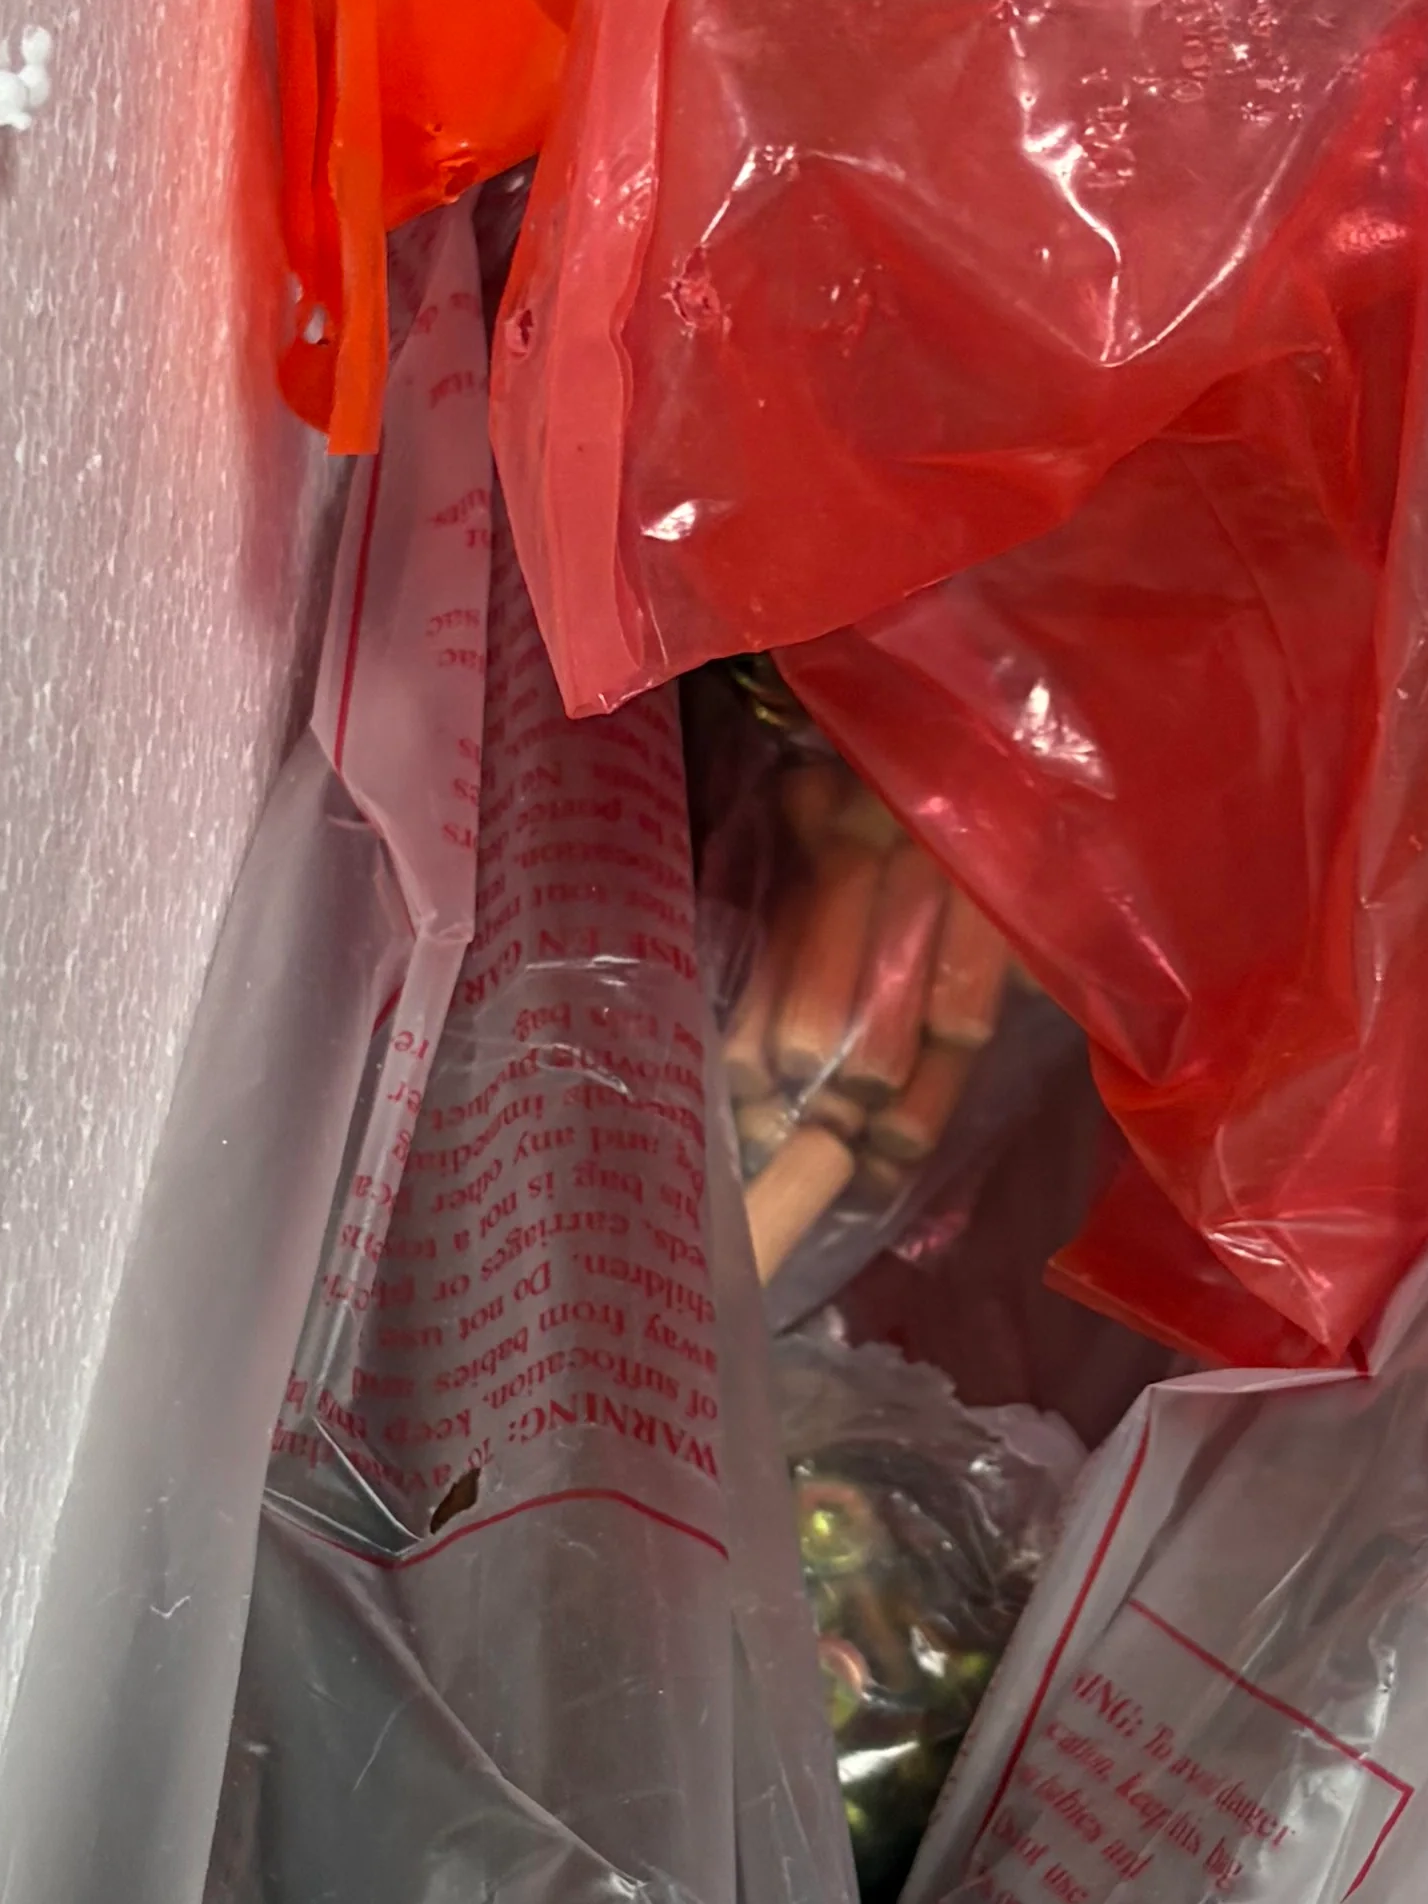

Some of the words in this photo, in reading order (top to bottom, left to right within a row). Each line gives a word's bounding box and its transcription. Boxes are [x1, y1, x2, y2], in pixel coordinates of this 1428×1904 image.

[527, 1170, 556, 1202] is
[452, 1228, 471, 1253] a
[481, 1211, 630, 1283] carriages
[434, 1273, 471, 1302] or
[512, 1259, 553, 1302] Do
[458, 1295, 505, 1341] not
[538, 1300, 625, 1340] from
[434, 1325, 530, 1394] babies
[481, 1346, 679, 1412] suffocation,
[685, 1389, 718, 1421] of
[507, 1392, 718, 1482] WARNING:
